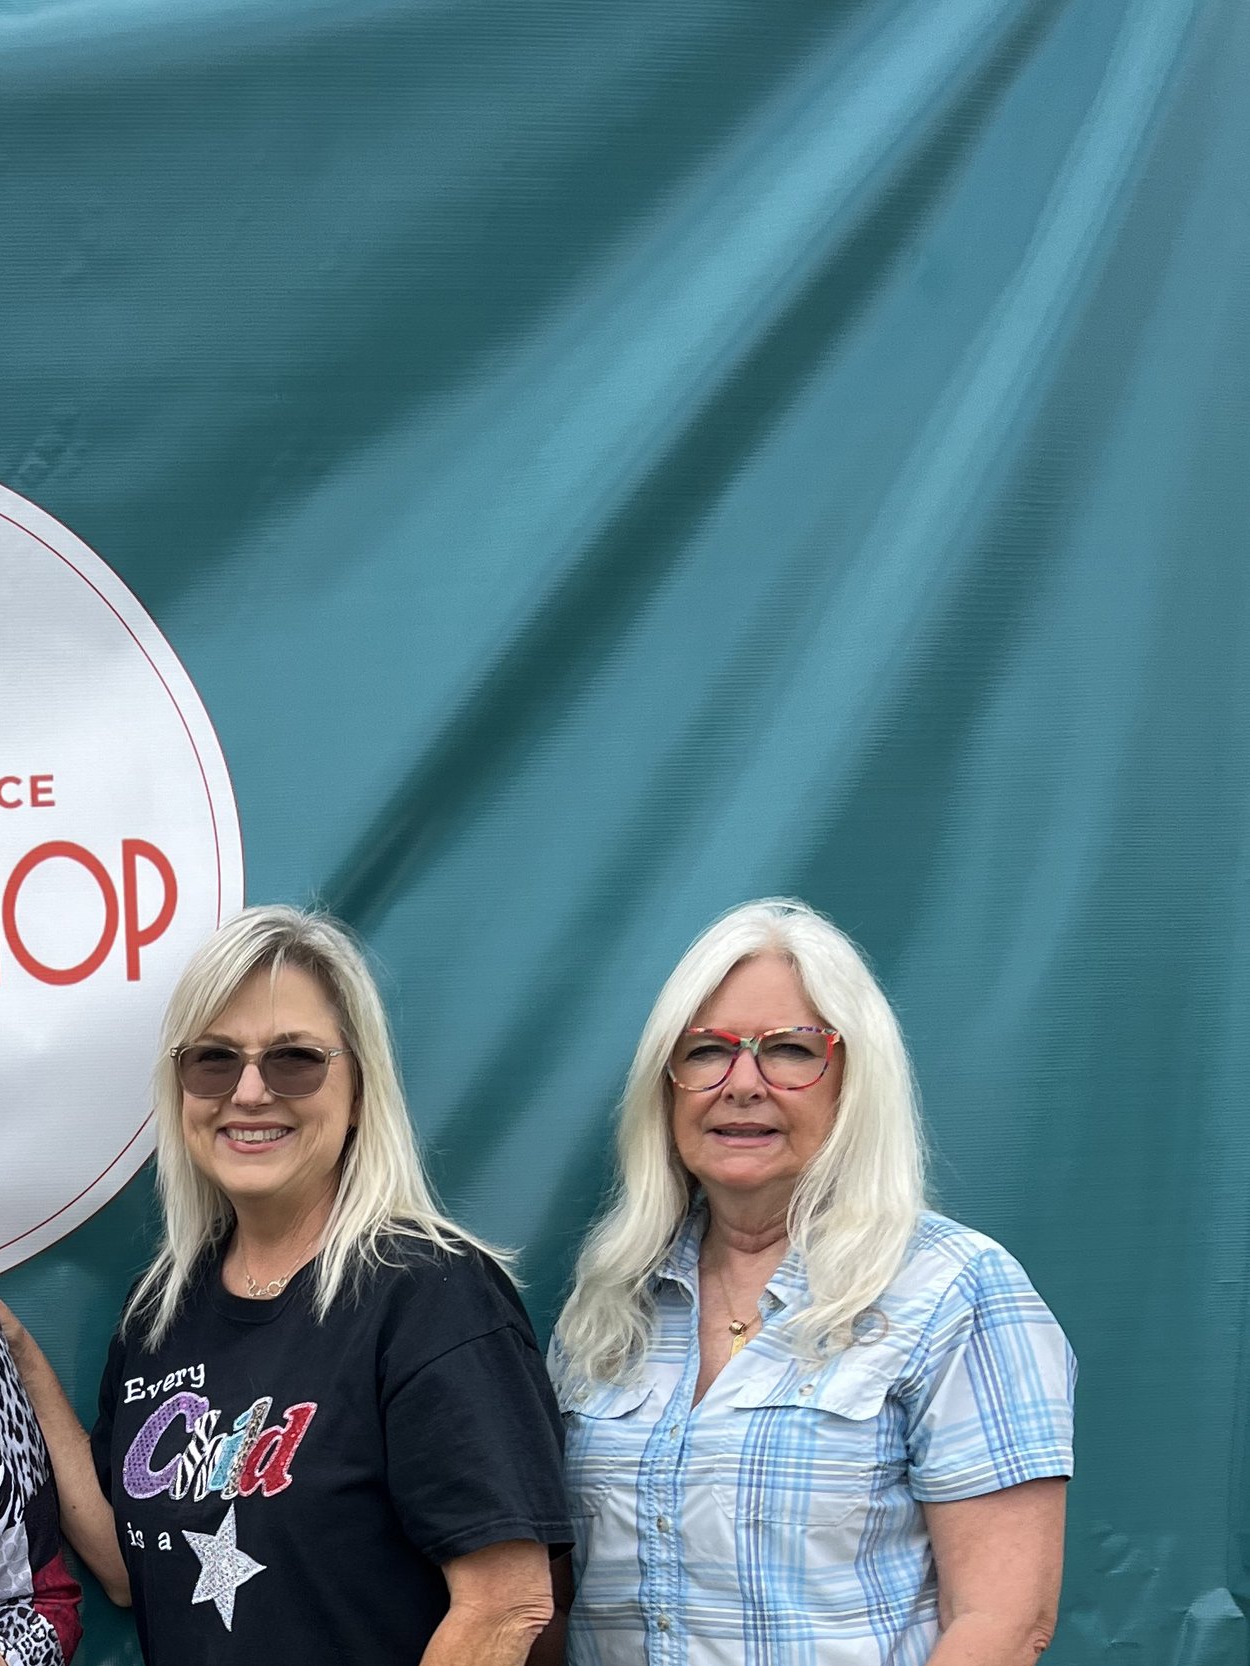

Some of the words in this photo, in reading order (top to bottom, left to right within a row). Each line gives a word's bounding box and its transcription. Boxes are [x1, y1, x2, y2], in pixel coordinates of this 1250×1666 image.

[123, 1363, 206, 1403] Every
[123, 1391, 318, 1502] Child
[126, 1521, 145, 1549] is
[157, 1531, 173, 1551] a
